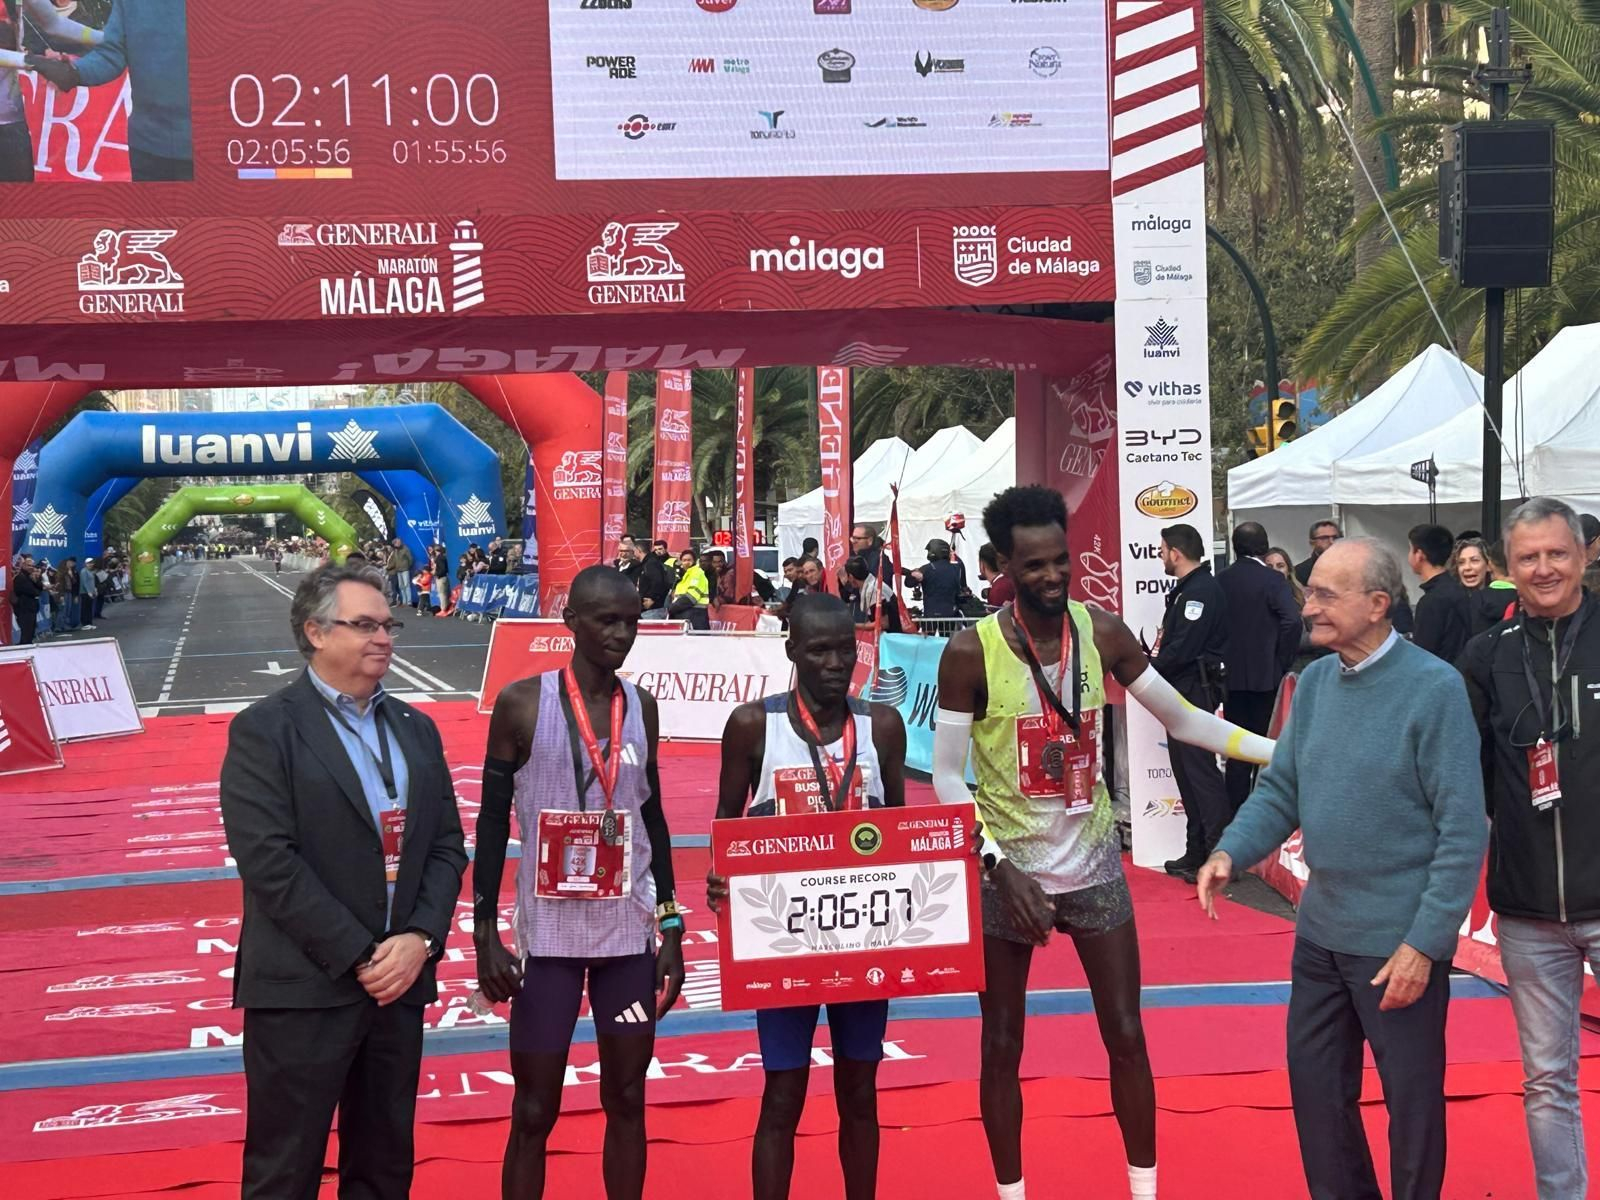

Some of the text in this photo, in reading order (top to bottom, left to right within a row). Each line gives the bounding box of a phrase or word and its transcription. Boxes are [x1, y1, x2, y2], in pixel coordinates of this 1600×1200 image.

[586, 56, 636, 68] POWER
[229, 73, 499, 128] 02:11:00
[227, 138, 350, 165] 02:05:56
[392, 139, 507, 164] 01:55:56
[316, 222, 439, 246] GENERALI
[1007, 235, 1072, 254] Ciudad
[377, 254, 438, 274] MARATÓN
[1008, 257, 1100, 276] de Málaga
[1155, 264, 1182, 273] Ciudad
[1155, 273, 1165, 281] de
[320, 270, 446, 315] MÁLAGA
[588, 283, 686, 305] GENERALI
[79, 292, 185, 314] GENERALI
[1143, 347, 1181, 358] luanvi
[1148, 380, 1202, 397] vithas
[141, 422, 312, 465] luanvi
[1125, 428, 1202, 446] BYD
[1126, 451, 1202, 464] Caetano Tec
[1142, 496, 1191, 507] Gourmet
[458, 524, 496, 537] luanvi
[28, 535, 68, 548] luanvi
[637, 671, 770, 704] GENERALI
[909, 818, 949, 829] GENERALI
[752, 834, 835, 855] GENERALI
[910, 836, 952, 852] MÁLAGA
[800, 872, 897, 887] COURSE RECORD
[787, 888, 912, 934] 2:06:07
